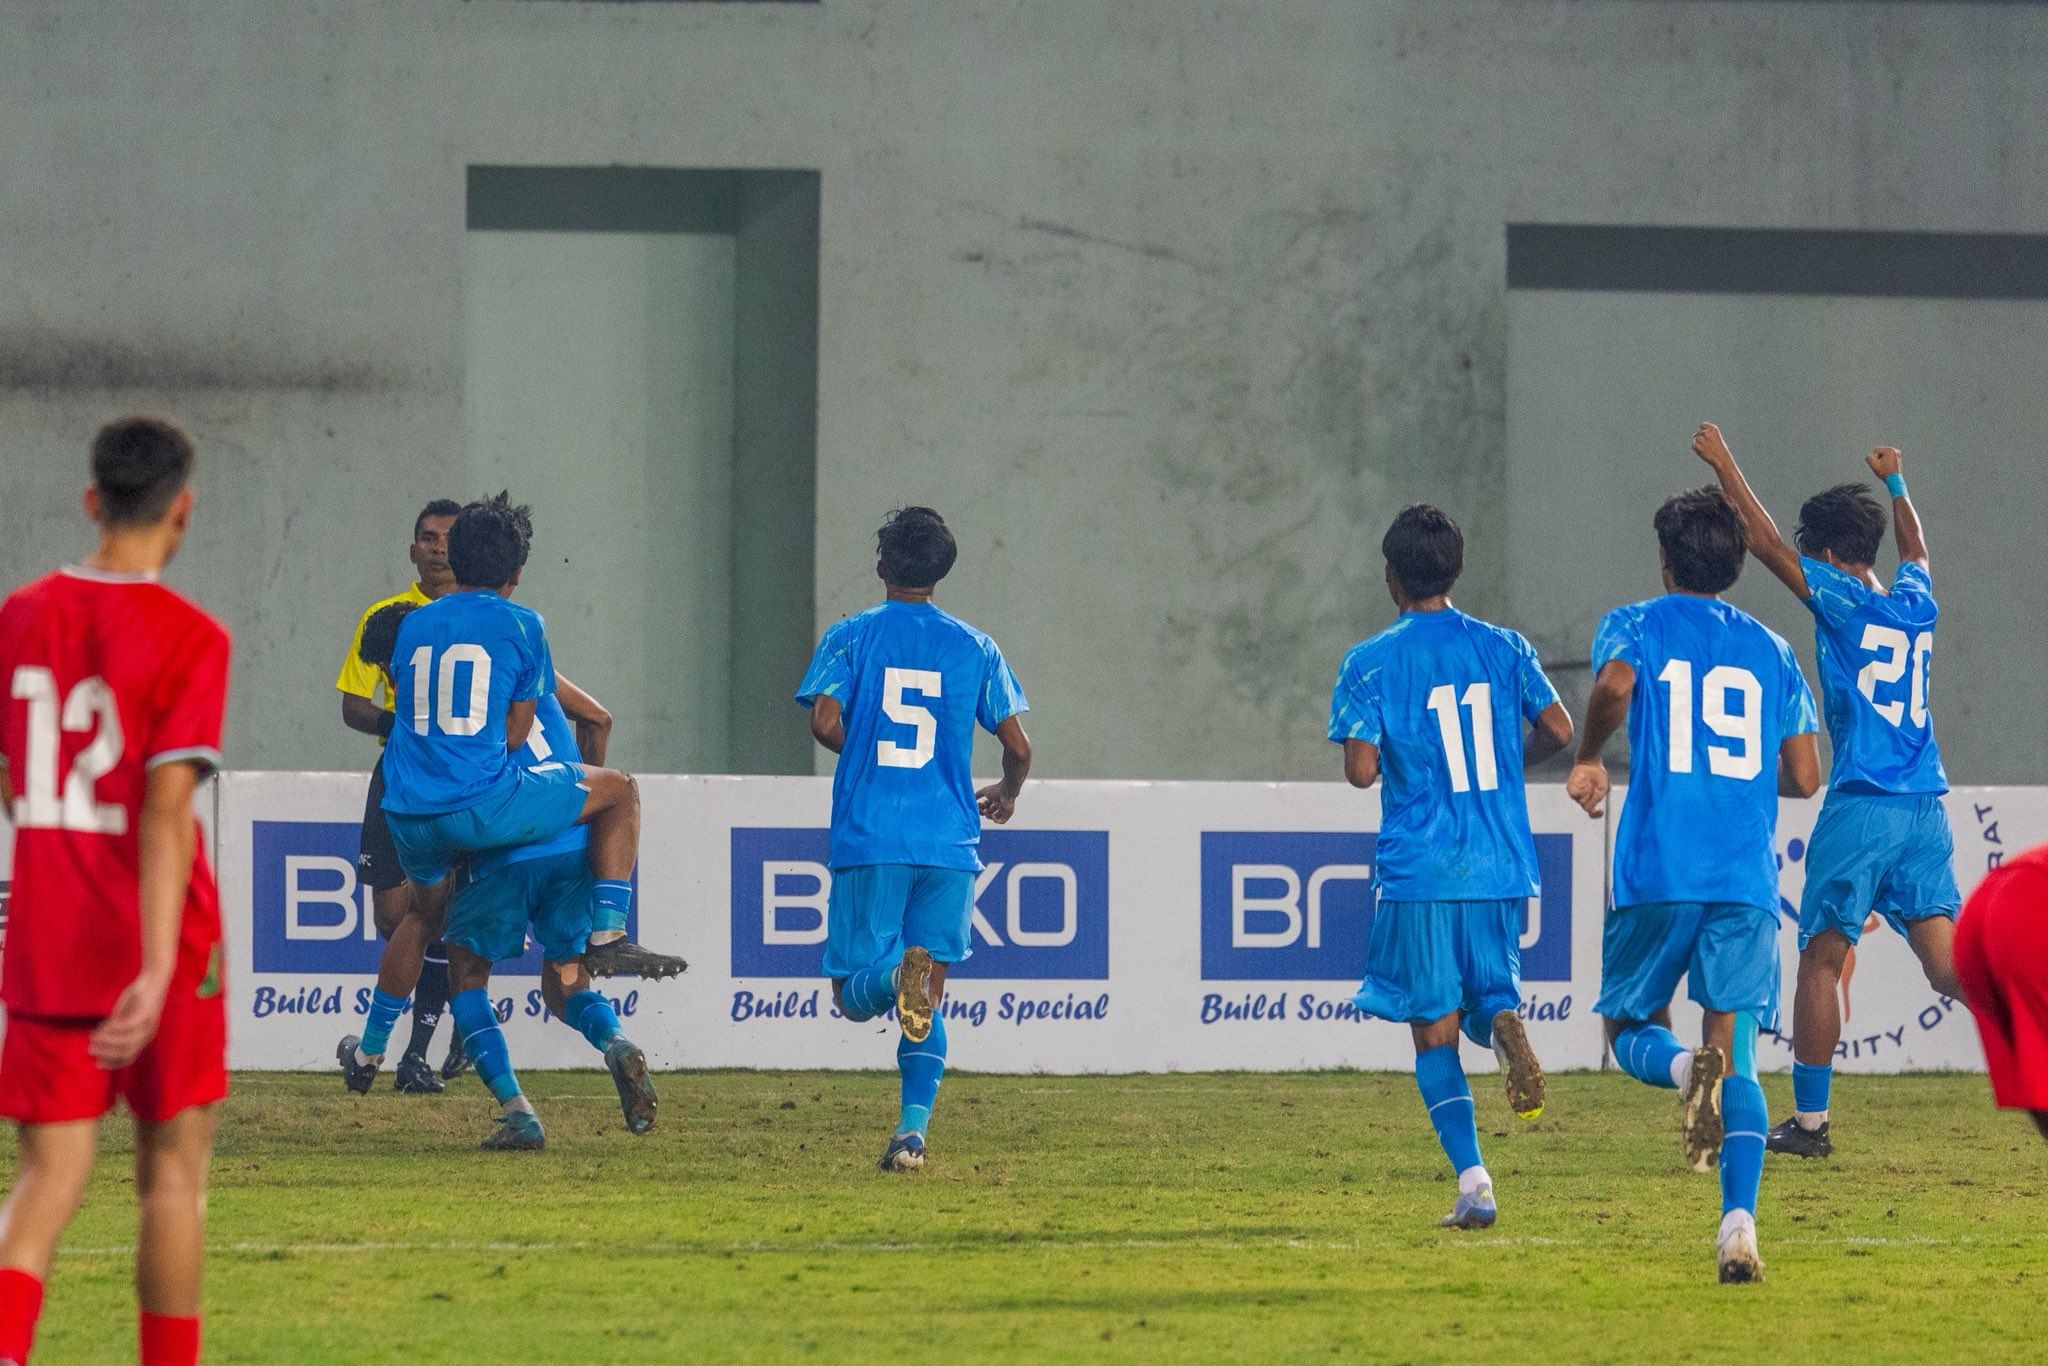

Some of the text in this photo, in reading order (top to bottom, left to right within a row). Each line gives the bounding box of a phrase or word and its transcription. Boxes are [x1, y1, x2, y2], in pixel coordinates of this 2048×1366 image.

[408, 643, 492, 737] 10
[877, 667, 942, 769] 5
[1657, 658, 1763, 781] 19
[1857, 623, 1933, 729] 20
[11, 664, 129, 837] 12
[1426, 682, 1498, 793] 11
[253, 986, 343, 1018] Build
[731, 990, 819, 1022] Build
[998, 992, 1109, 1027] Special
[1201, 992, 1287, 1024] Build
[1516, 994, 1572, 1021] cial
